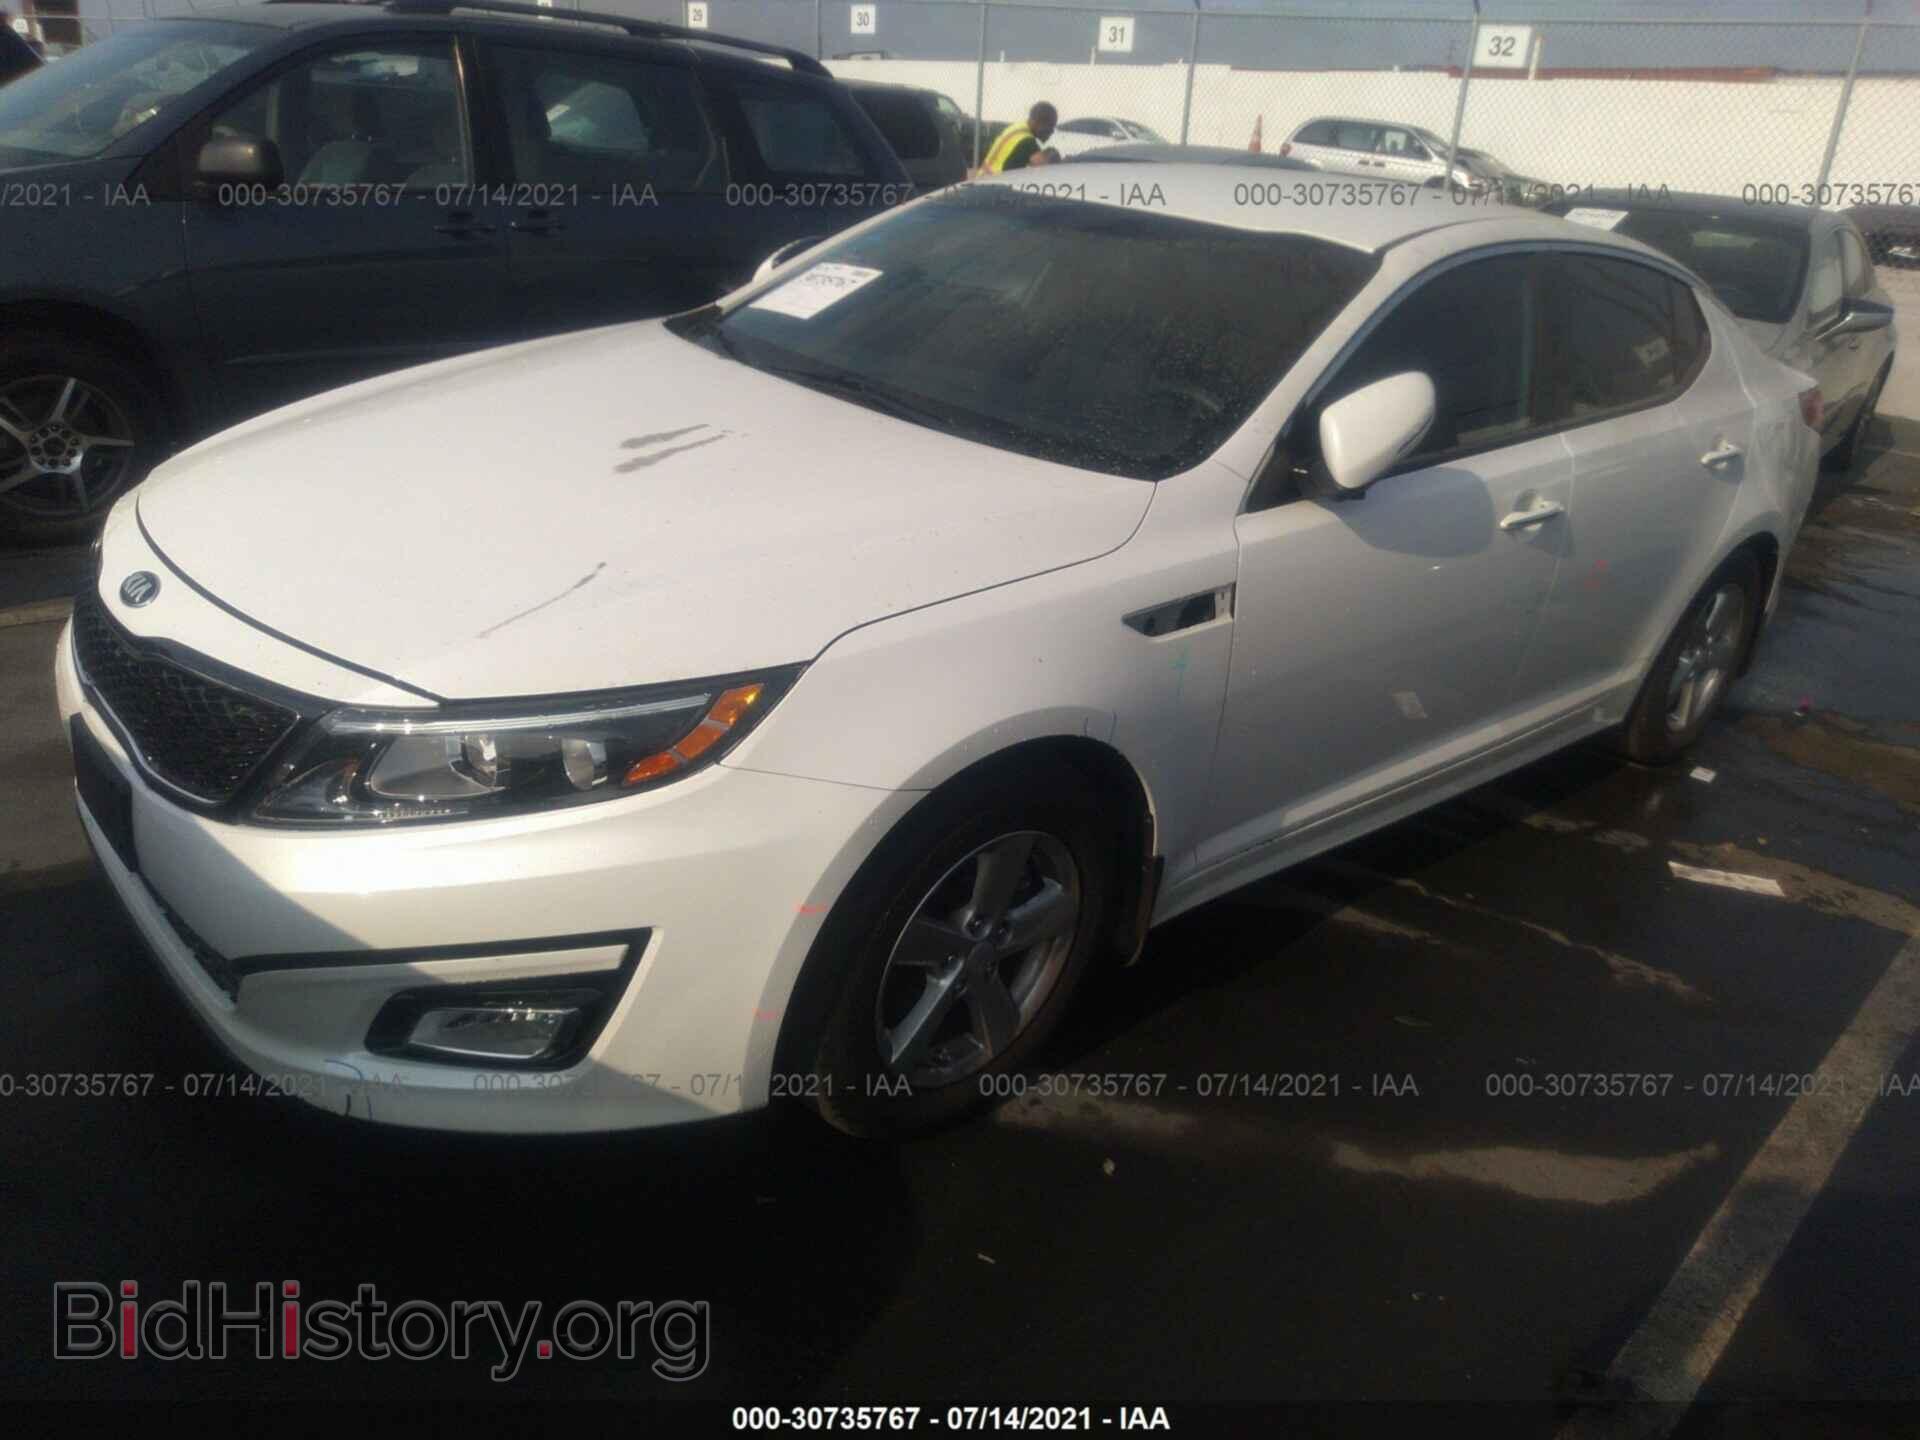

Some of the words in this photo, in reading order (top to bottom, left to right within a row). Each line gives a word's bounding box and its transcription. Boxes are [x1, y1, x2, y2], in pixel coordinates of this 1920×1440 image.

[857, 11, 870, 26] 30
[1109, 26, 1125, 43] 31
[1489, 36, 1515, 56] 32
